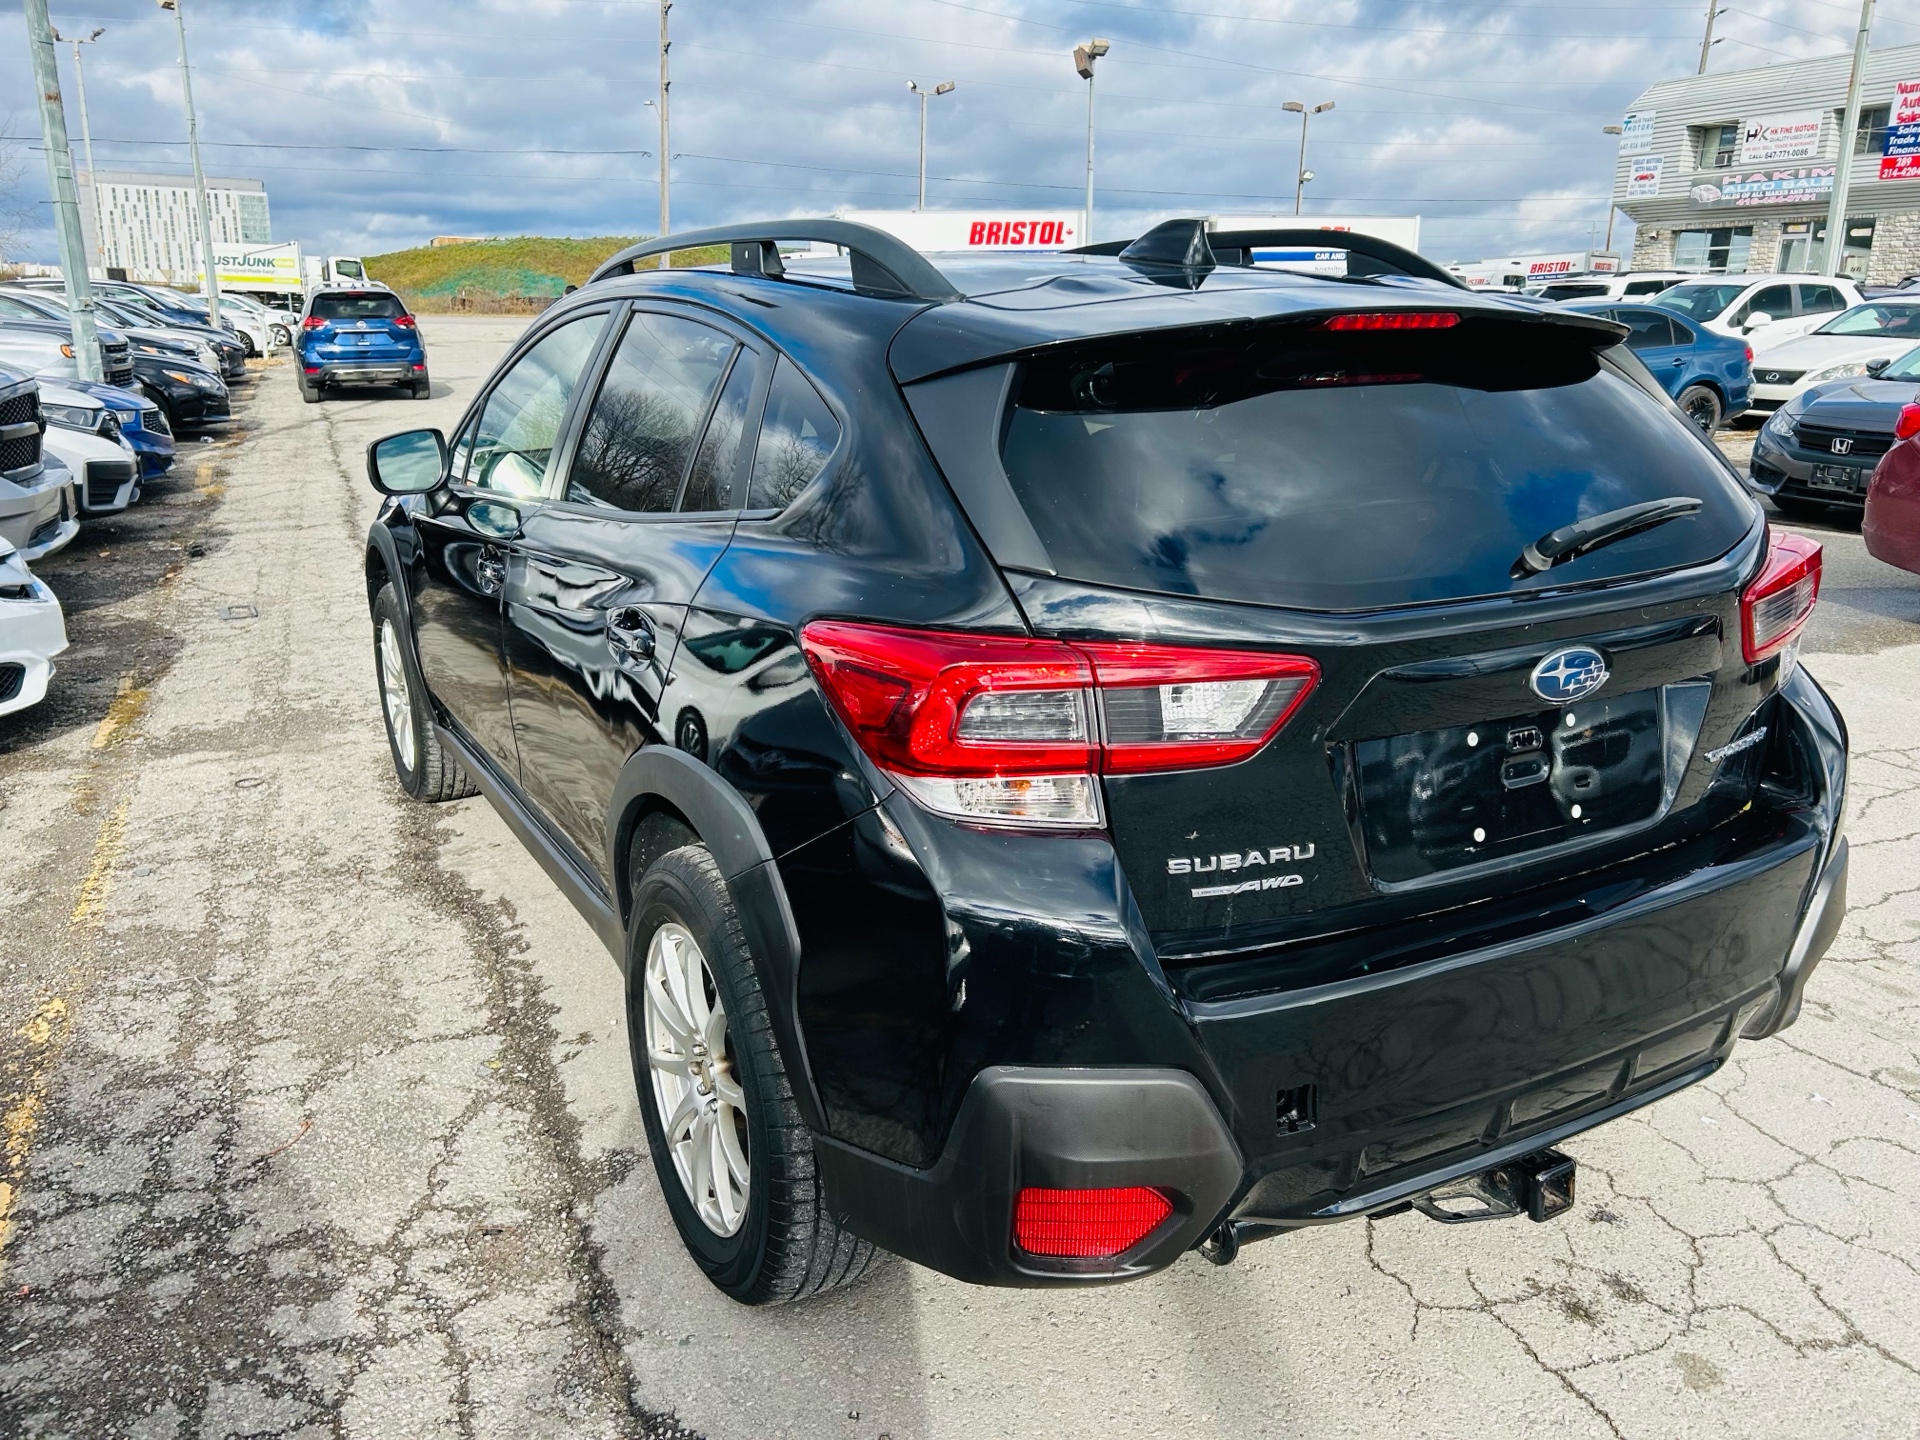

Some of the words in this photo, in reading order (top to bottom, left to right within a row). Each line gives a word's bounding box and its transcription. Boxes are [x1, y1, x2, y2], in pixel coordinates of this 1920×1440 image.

[1780, 126, 1793, 134] FINE
[1794, 123, 1818, 133] MOTORS
[1889, 135, 1916, 145] Trade
[1765, 148, 1809, 159] 647-771-0086
[1895, 157, 1913, 168] 289
[1722, 167, 1836, 184] HAKIM
[1722, 182, 1775, 194] AUTO
[969, 221, 1064, 245] BRISTOL
[1530, 262, 1570, 273] BRISTOL
[1594, 262, 1612, 271] BRISTOL
[1166, 842, 1315, 875] SUBARU
[1234, 874, 1304, 894] AWD
